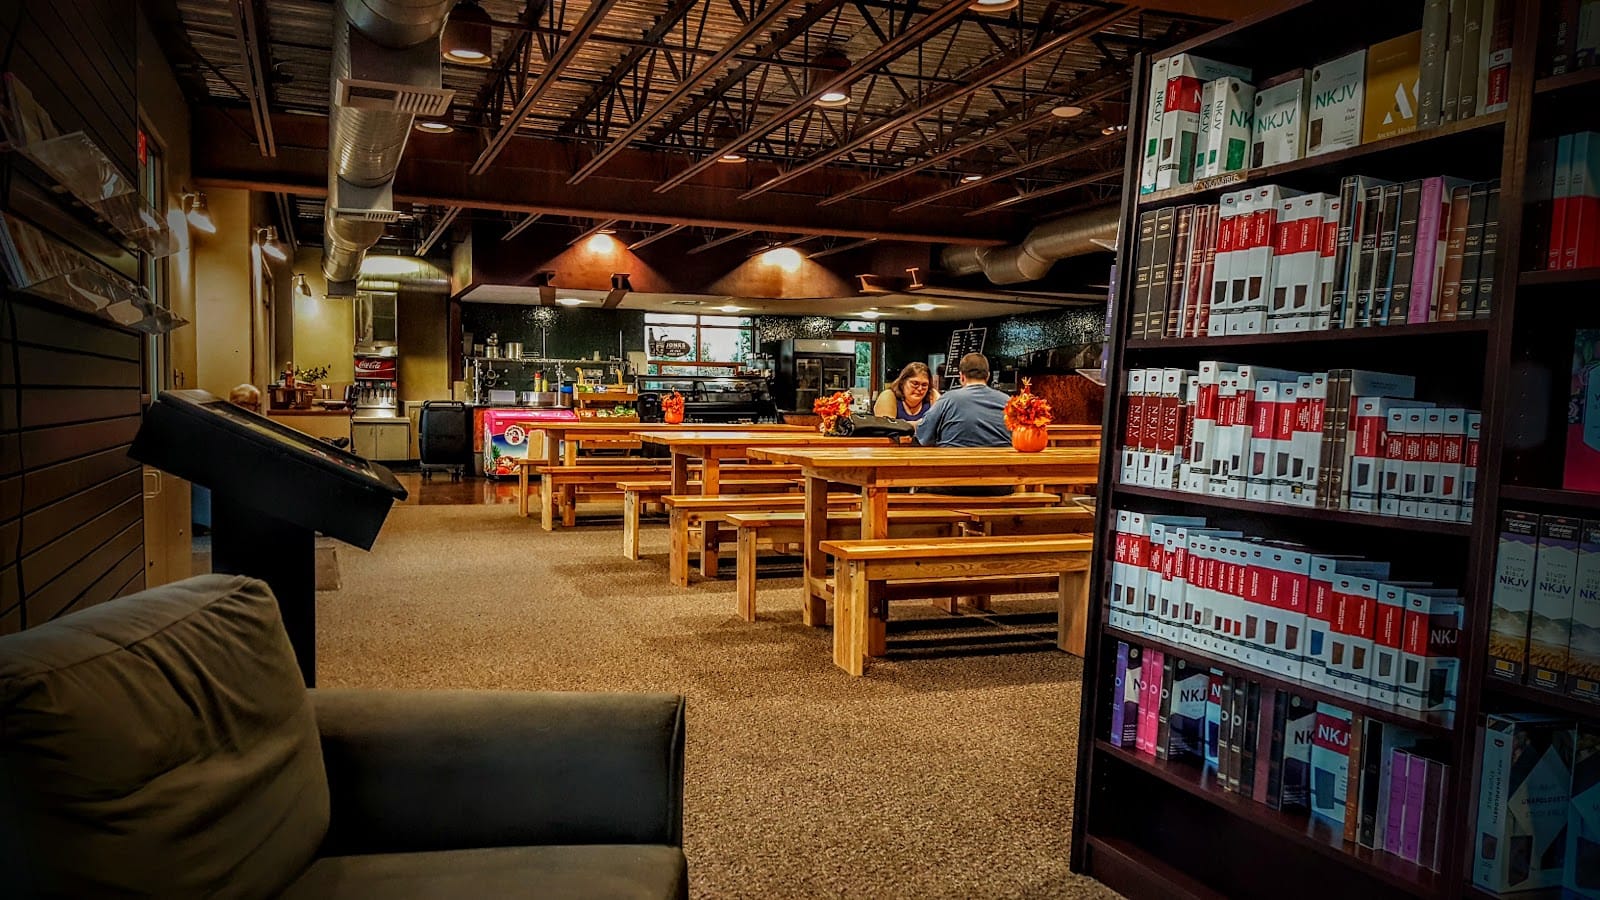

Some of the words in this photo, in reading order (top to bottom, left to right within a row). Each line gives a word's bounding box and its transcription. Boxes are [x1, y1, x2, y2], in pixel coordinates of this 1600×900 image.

[1153, 90, 1164, 123] NKJV
[1315, 81, 1358, 110] NKJV
[1201, 103, 1211, 135] NKJV
[1214, 100, 1224, 131] NKJV
[1230, 109, 1254, 131] NK
[1257, 108, 1296, 134] NKJV
[1131, 405, 1142, 438] NKJV
[1149, 405, 1159, 440] NKJV
[1166, 406, 1176, 441] NKJV
[1499, 575, 1529, 588] NKJV
[1539, 582, 1572, 594] NKJV
[1580, 589, 1600, 602] NK
[1430, 629, 1458, 645] NKJ
[1180, 689, 1206, 703] NKJ
[1294, 730, 1314, 744] NK
[1317, 723, 1351, 746] NKJ
